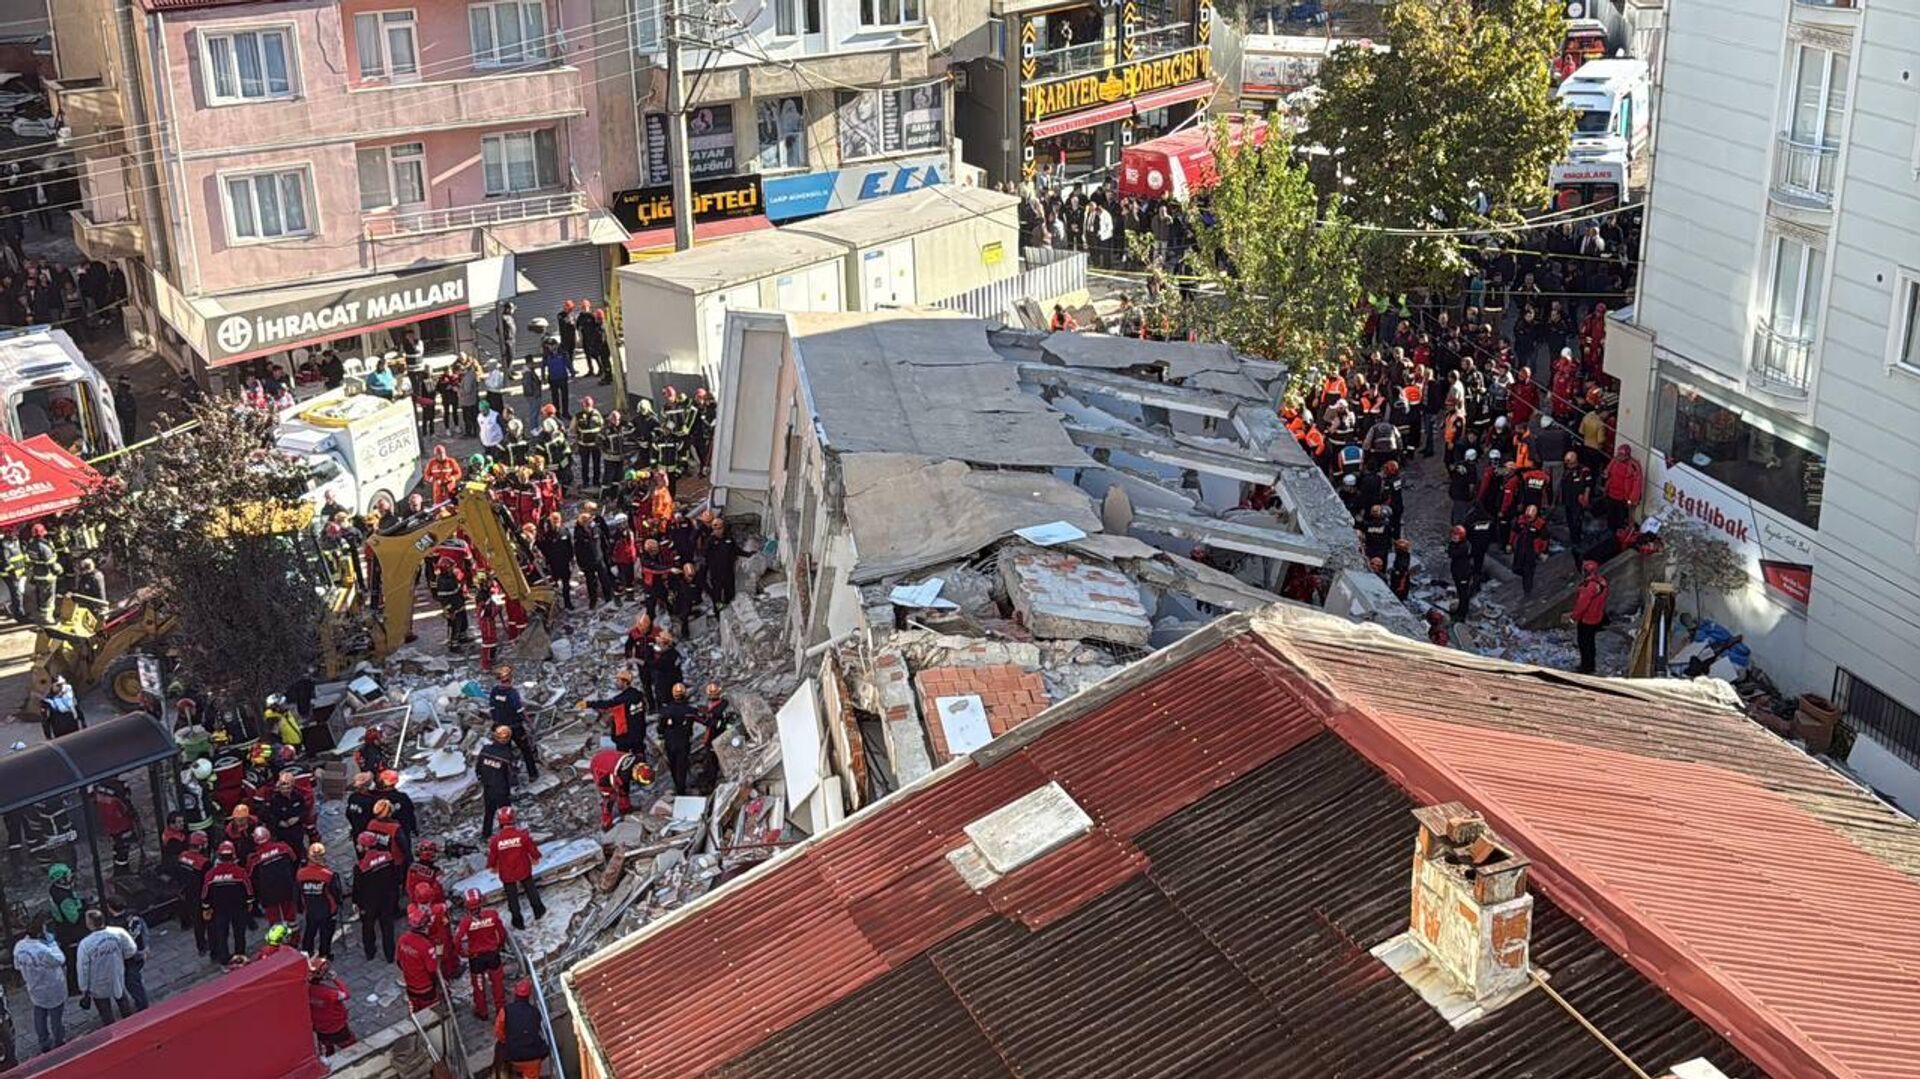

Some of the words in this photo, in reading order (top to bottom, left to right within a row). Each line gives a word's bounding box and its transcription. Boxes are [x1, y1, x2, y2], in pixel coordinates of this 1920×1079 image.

[689, 149, 724, 160] AYAN
[257, 302, 359, 343] İHRACAT
[367, 279, 463, 319] MALLARI
[1677, 489, 1749, 543] tatlıbak
